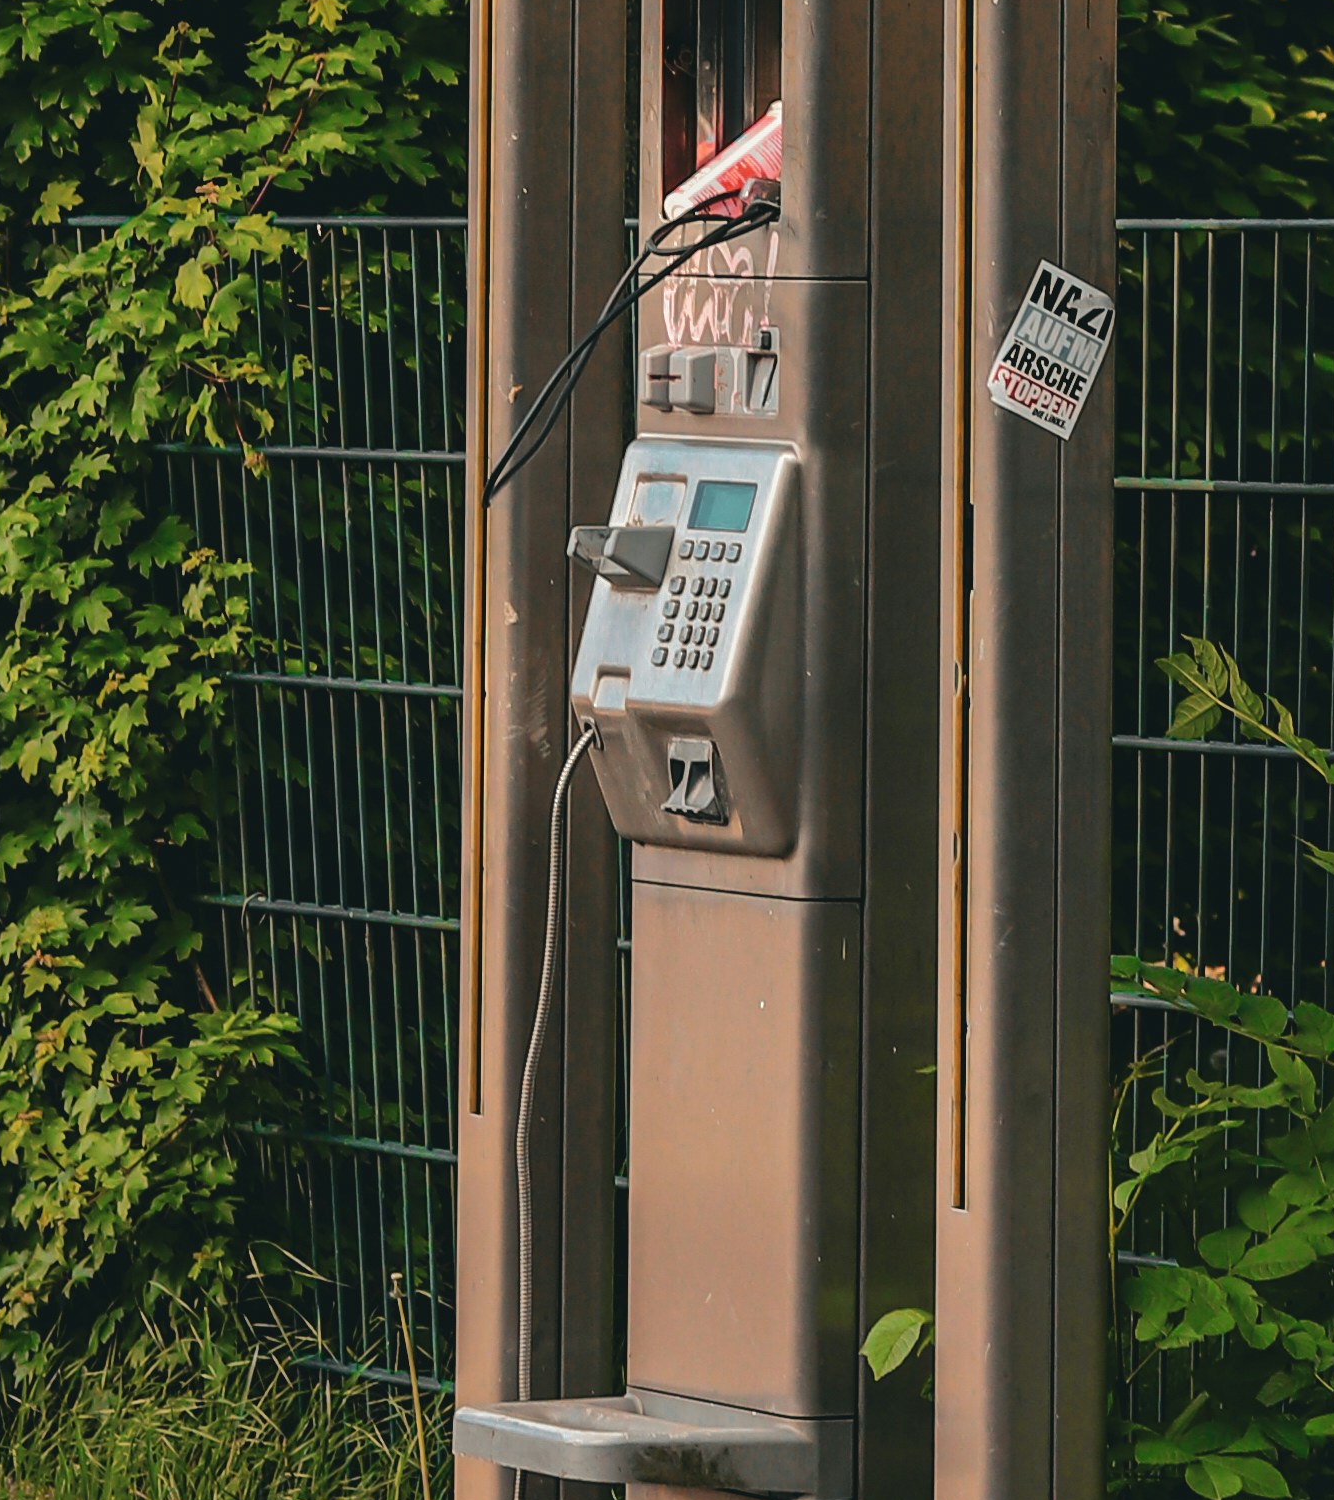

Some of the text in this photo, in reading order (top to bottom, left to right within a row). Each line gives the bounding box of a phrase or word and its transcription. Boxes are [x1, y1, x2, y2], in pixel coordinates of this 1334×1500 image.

[1030, 269, 1114, 341] NAZI
[996, 367, 1074, 419] STOPPEN
[1002, 338, 1087, 401] ÄRSCHE
